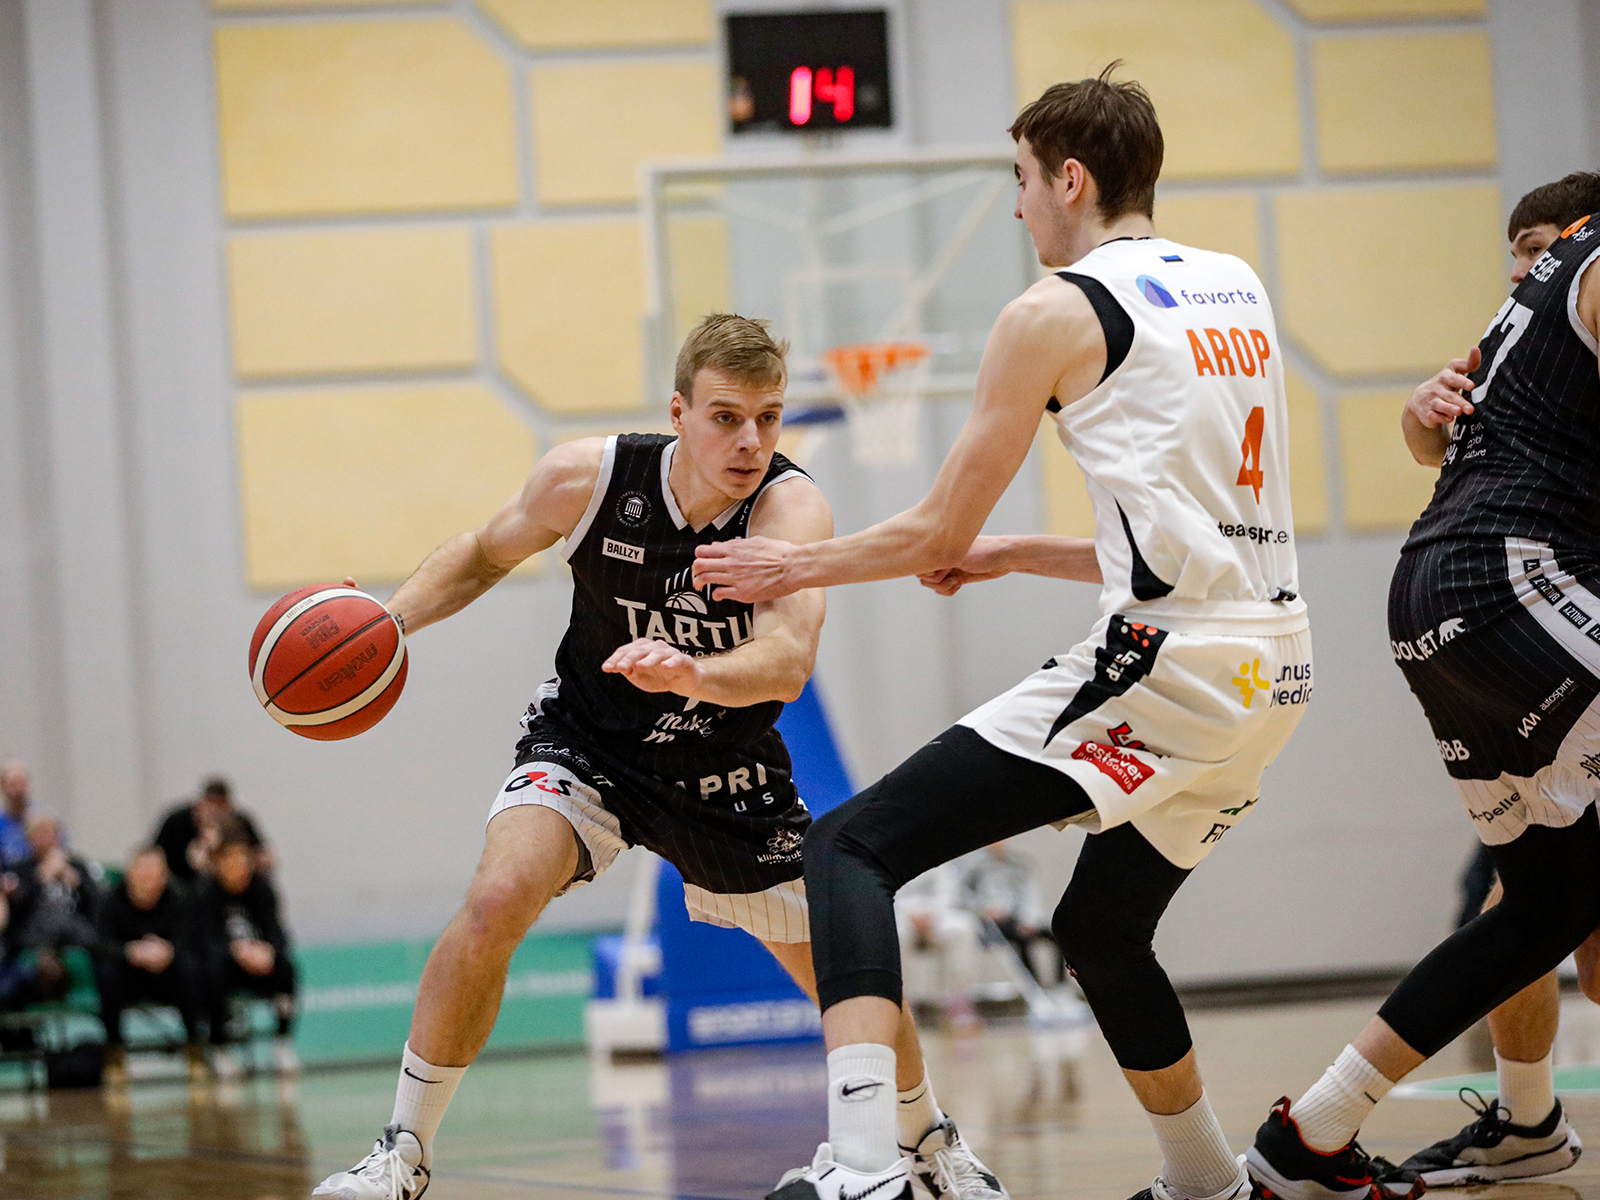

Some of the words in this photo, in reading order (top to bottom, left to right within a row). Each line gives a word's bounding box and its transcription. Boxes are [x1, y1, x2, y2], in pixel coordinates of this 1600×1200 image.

[789, 65, 855, 125] 14
[1181, 288, 1258, 305] favorte
[1186, 327, 1270, 378] AROP
[1236, 406, 1264, 505] 4
[606, 542, 640, 560] BALLZY
[305, 619, 340, 649] FIBA
[614, 597, 755, 650] TARTU
[1562, 605, 1587, 625] BALLZY
[317, 643, 379, 692] molten
